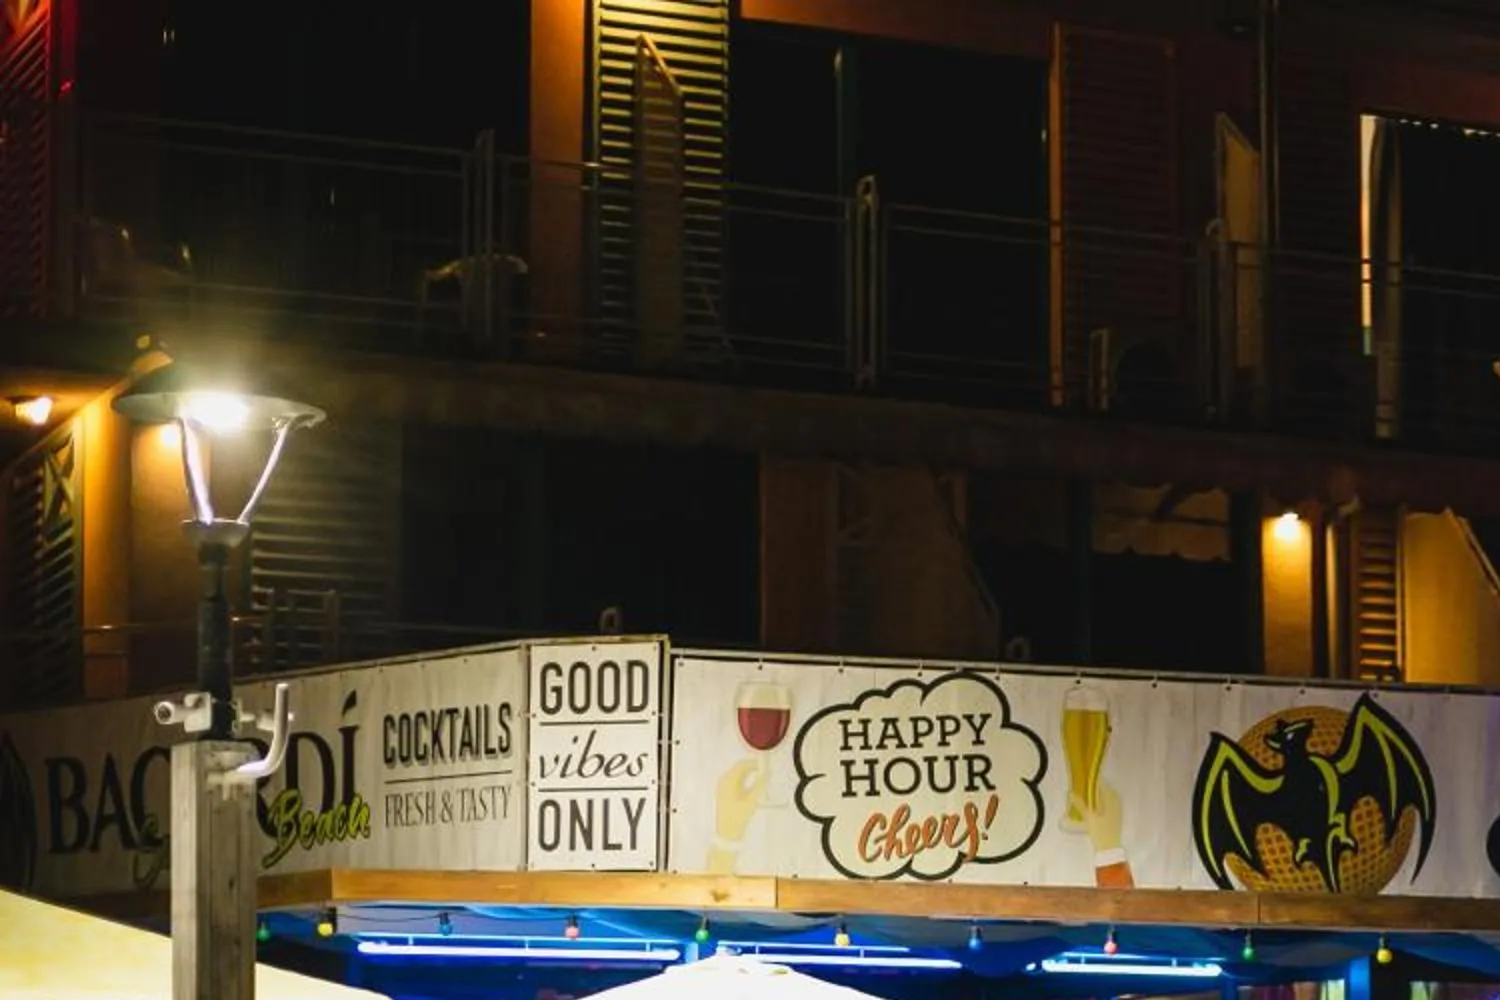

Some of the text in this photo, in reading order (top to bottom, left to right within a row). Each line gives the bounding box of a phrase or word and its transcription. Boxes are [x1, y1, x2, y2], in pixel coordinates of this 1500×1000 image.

[539, 659, 649, 715] GOOD
[382, 701, 512, 770] COCKTAILS
[537, 731, 648, 781] vibes
[838, 711, 993, 751] HAPPY
[841, 753, 997, 798] HOUR
[262, 788, 370, 868] Beach
[384, 784, 512, 830] FRESH & TASTY
[538, 798, 646, 852] ONLY
[856, 794, 1001, 864] Cheers!
